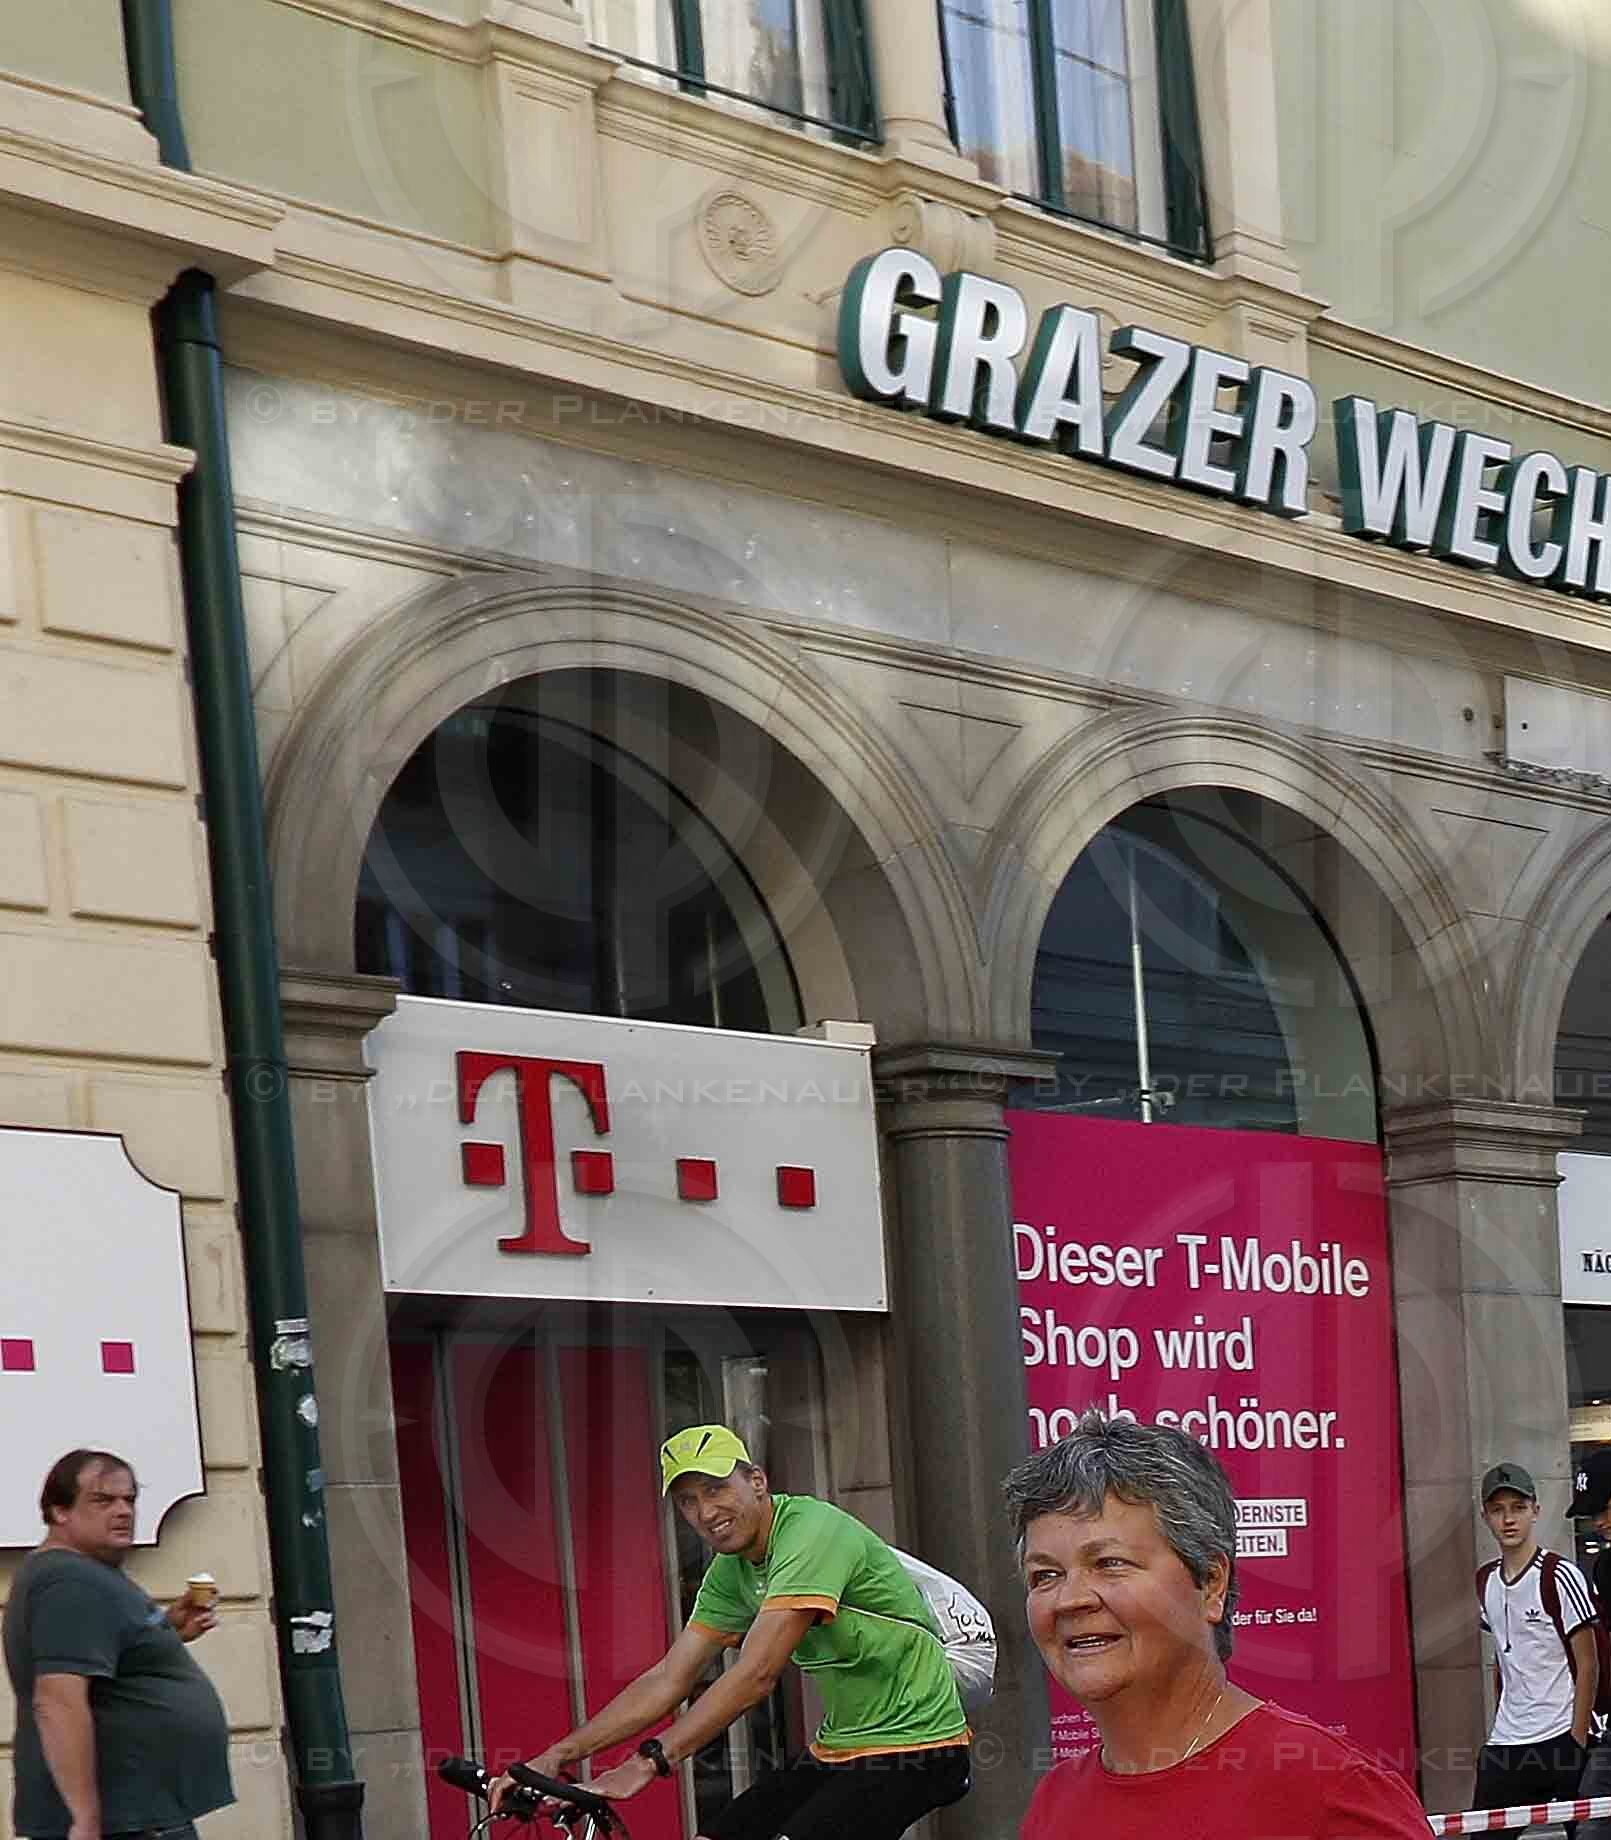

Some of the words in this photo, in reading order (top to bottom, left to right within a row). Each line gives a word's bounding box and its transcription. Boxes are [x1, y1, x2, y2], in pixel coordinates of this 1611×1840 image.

[846, 248, 1318, 515] GRAZER
[456, 1051, 613, 1255] T
[1014, 1224, 1164, 1288] Dieser
[1176, 1234, 1370, 1297] T-Mobile
[1019, 1306, 1139, 1380] Shop
[1153, 1315, 1255, 1371] wird
